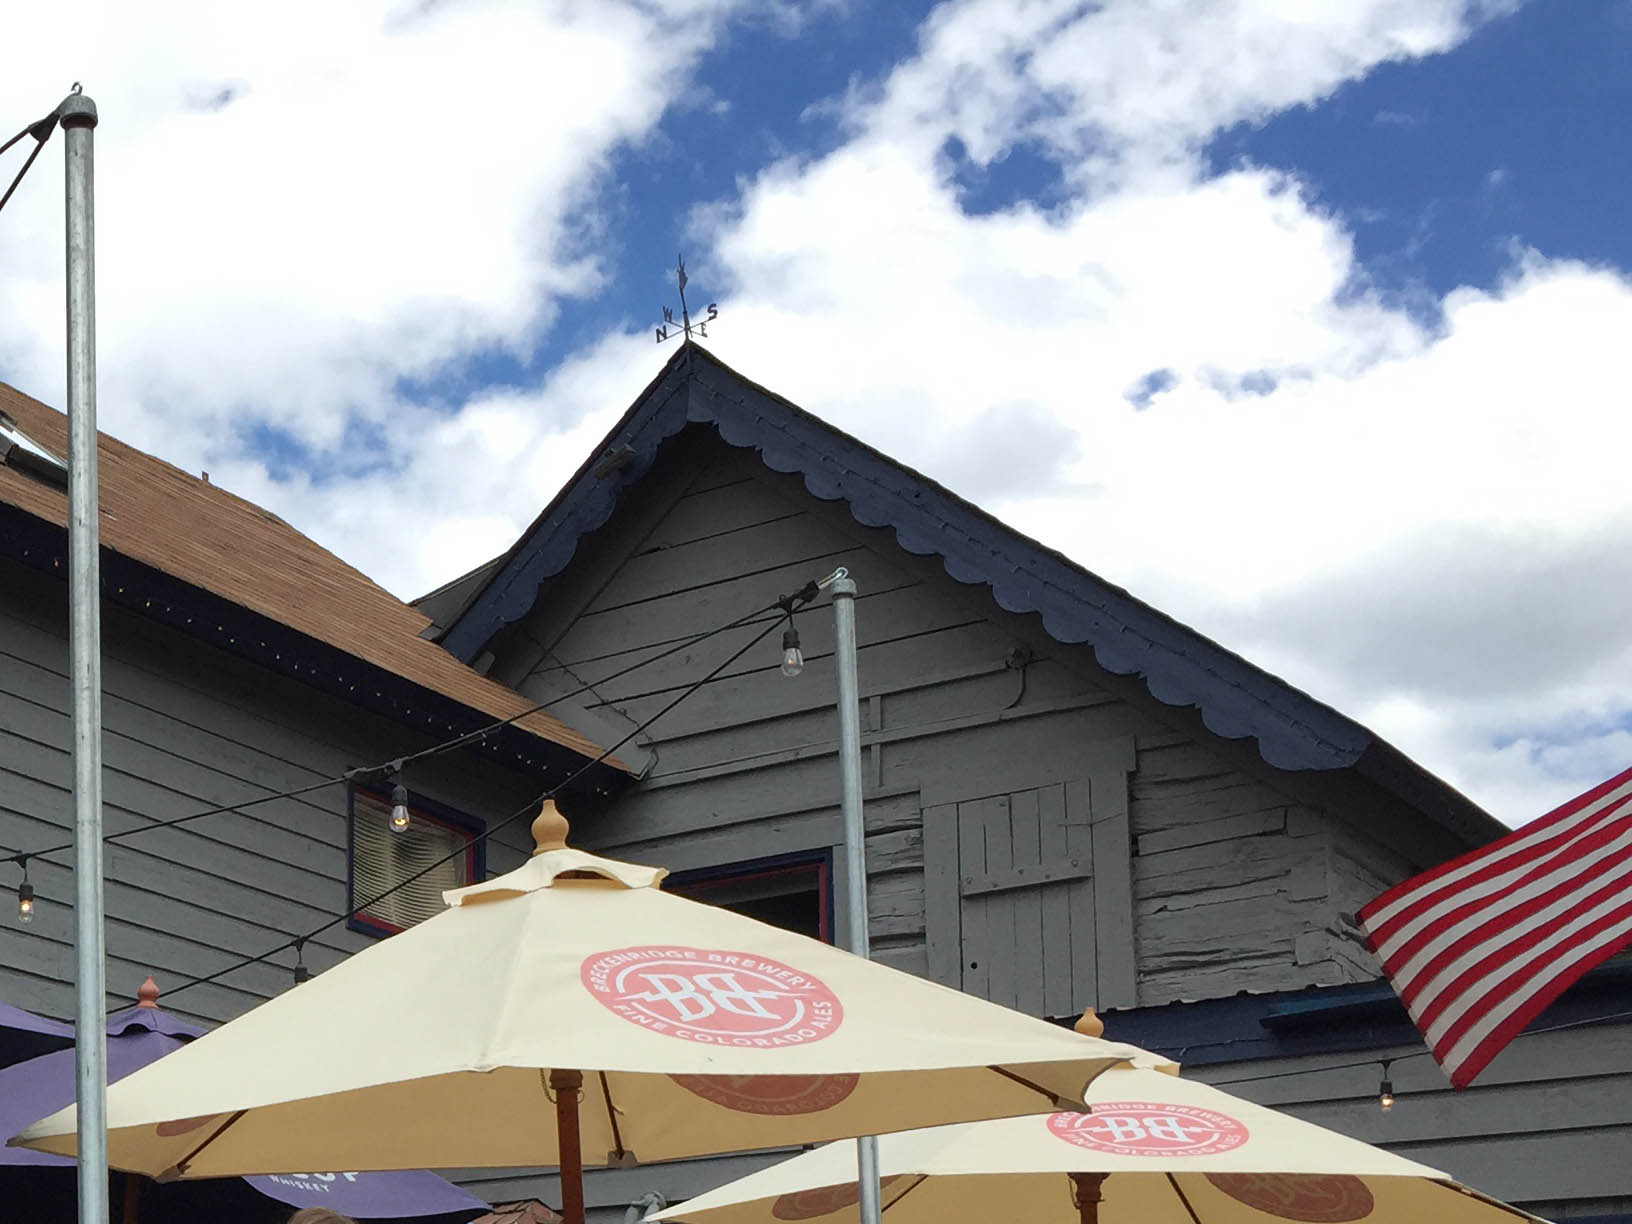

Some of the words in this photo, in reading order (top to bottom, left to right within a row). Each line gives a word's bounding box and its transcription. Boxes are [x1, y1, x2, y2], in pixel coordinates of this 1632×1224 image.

[589, 949, 696, 993] BRECKENRIDGE
[708, 953, 817, 991] BREWERY
[612, 1003, 666, 1032] FINE
[675, 1027, 817, 1048] COLORADO
[813, 1000, 834, 1030] ALES
[268, 1175, 330, 1193] WHISKEY
